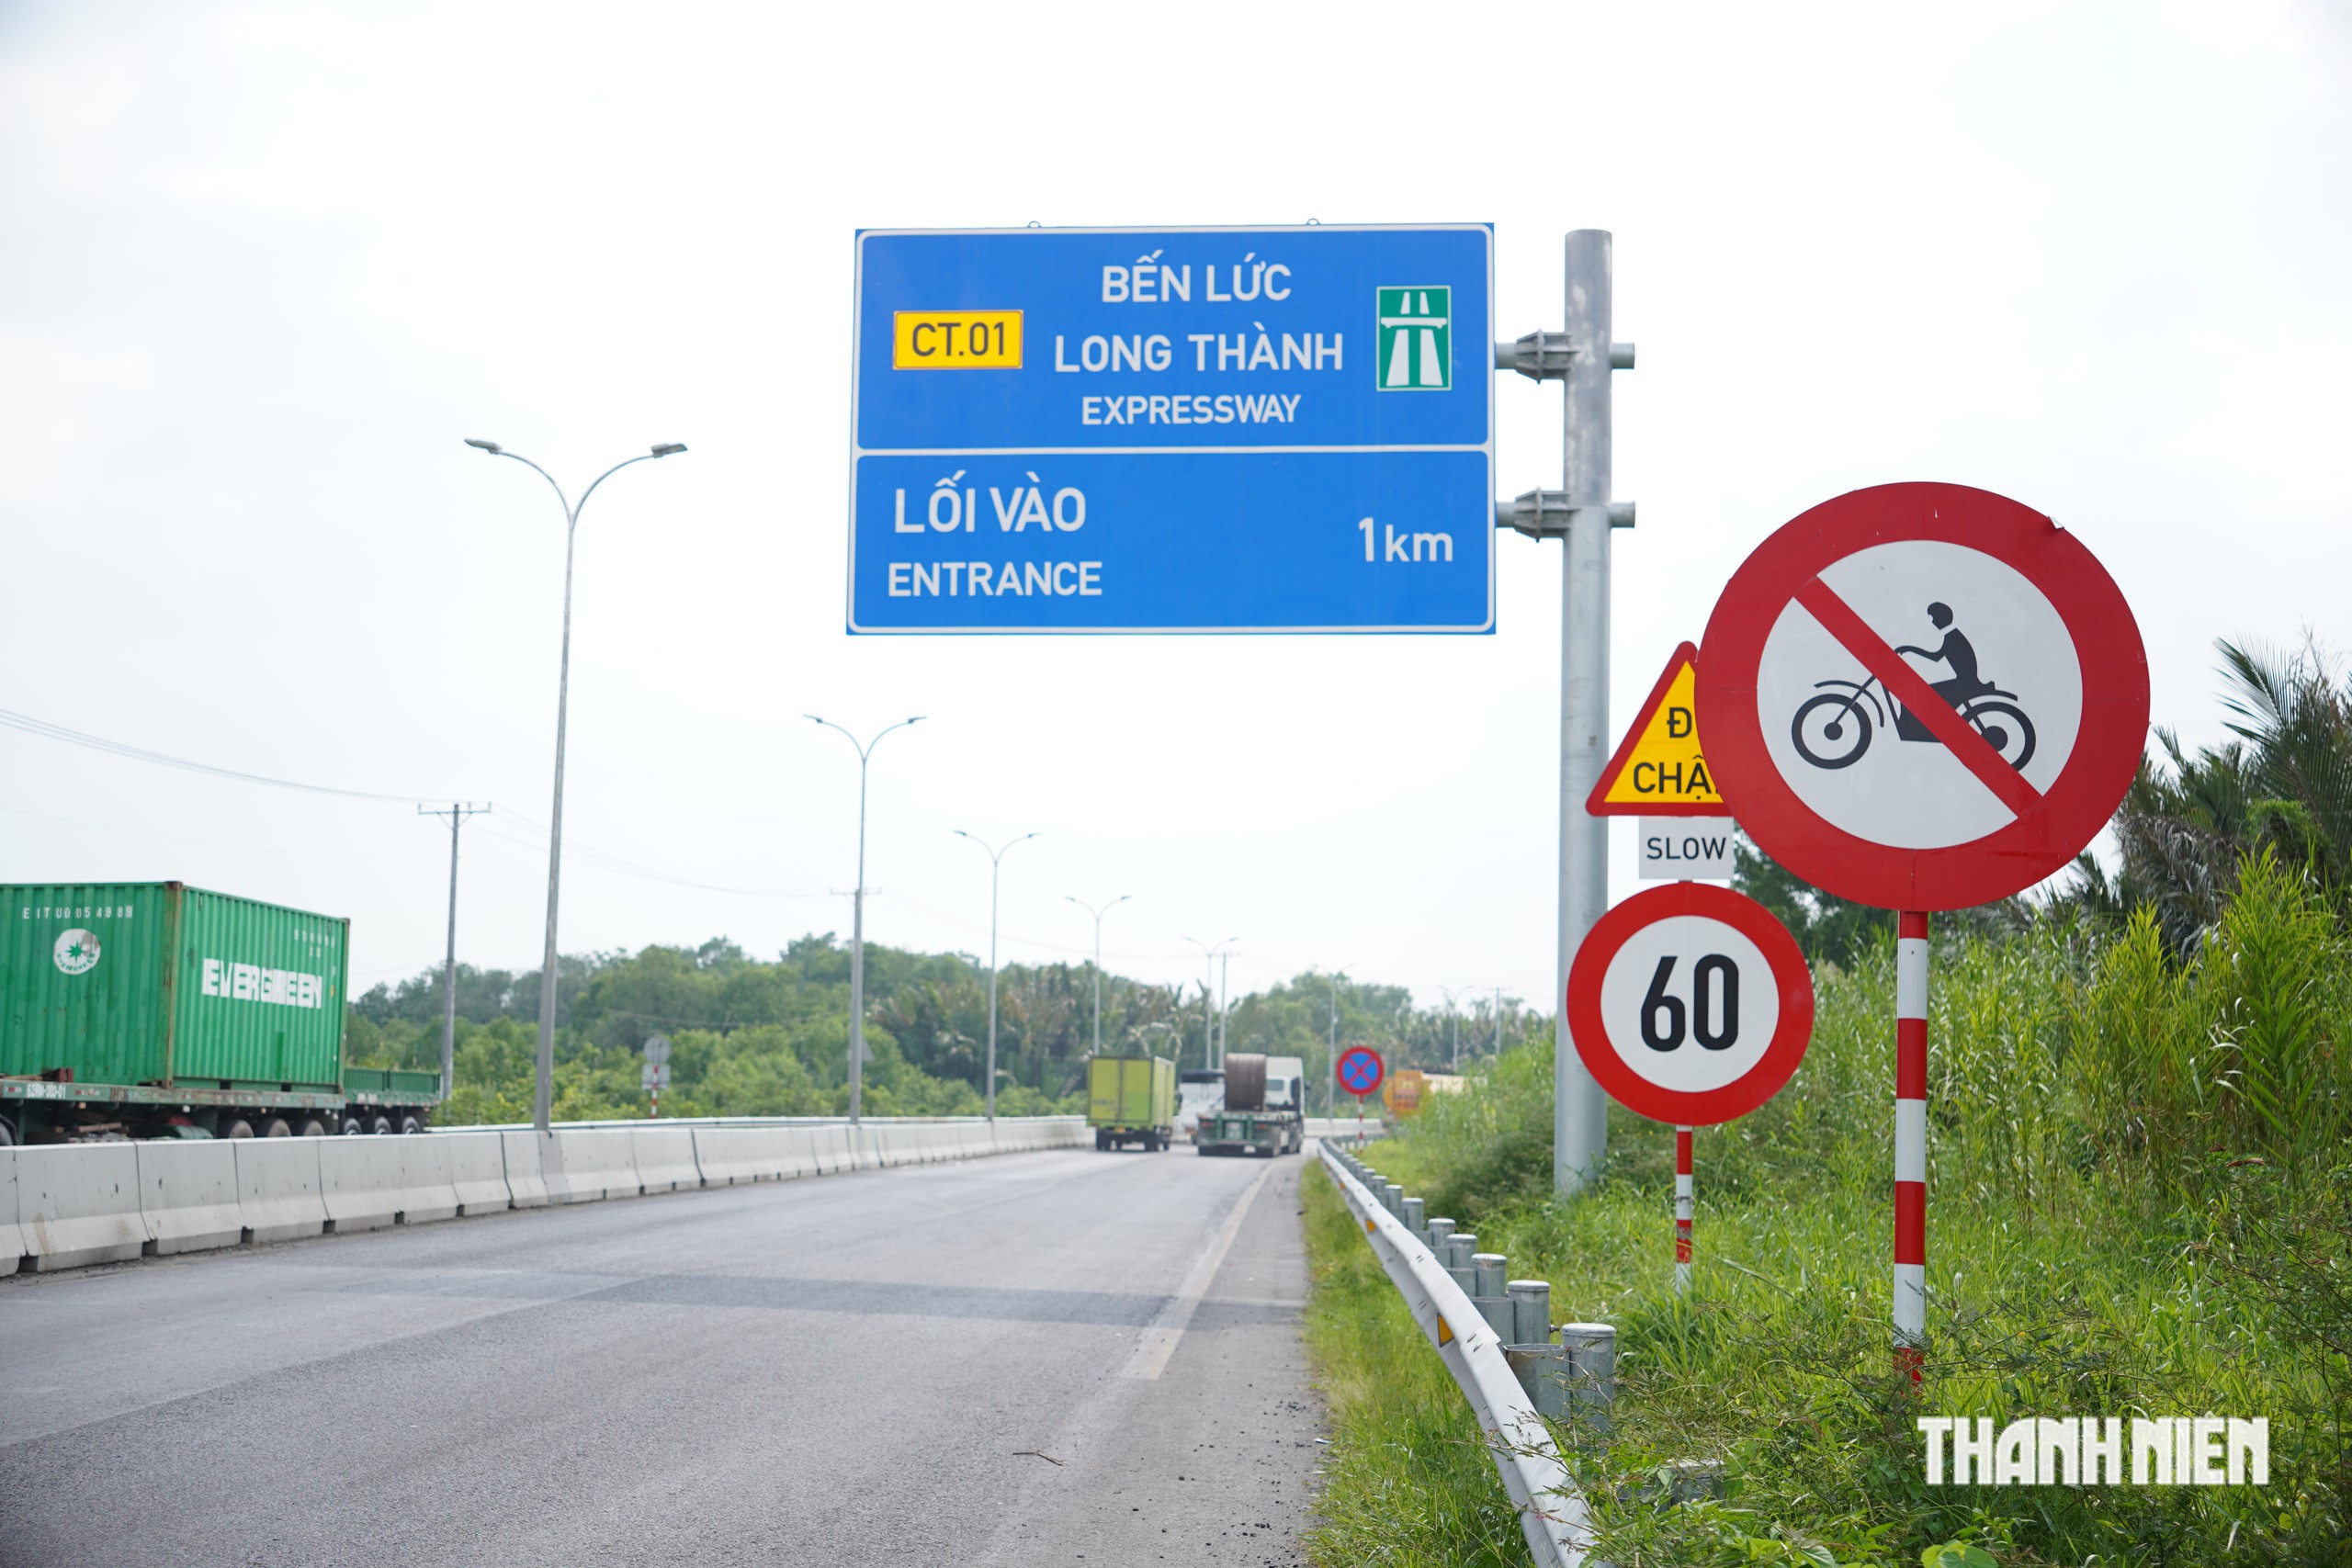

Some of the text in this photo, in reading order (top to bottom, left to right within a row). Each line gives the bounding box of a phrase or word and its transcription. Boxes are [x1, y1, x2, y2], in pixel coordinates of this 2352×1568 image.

[1102, 249, 1292, 303] BẾN LỨC
[912, 322, 1003, 356] CT.01
[1055, 321, 1343, 373] LONG THÀNH
[1082, 394, 1302, 425] EXPRESSWAY
[895, 469, 1086, 534] LỐI VÀO
[888, 561, 1102, 597] ENTRANCE
[1667, 706, 1692, 739] Đ
[1633, 754, 1718, 800] CHẬ
[1646, 837, 1727, 861] SLOW
[201, 957, 322, 1010] EVERGREEN
[1640, 953, 1740, 1053] 60
